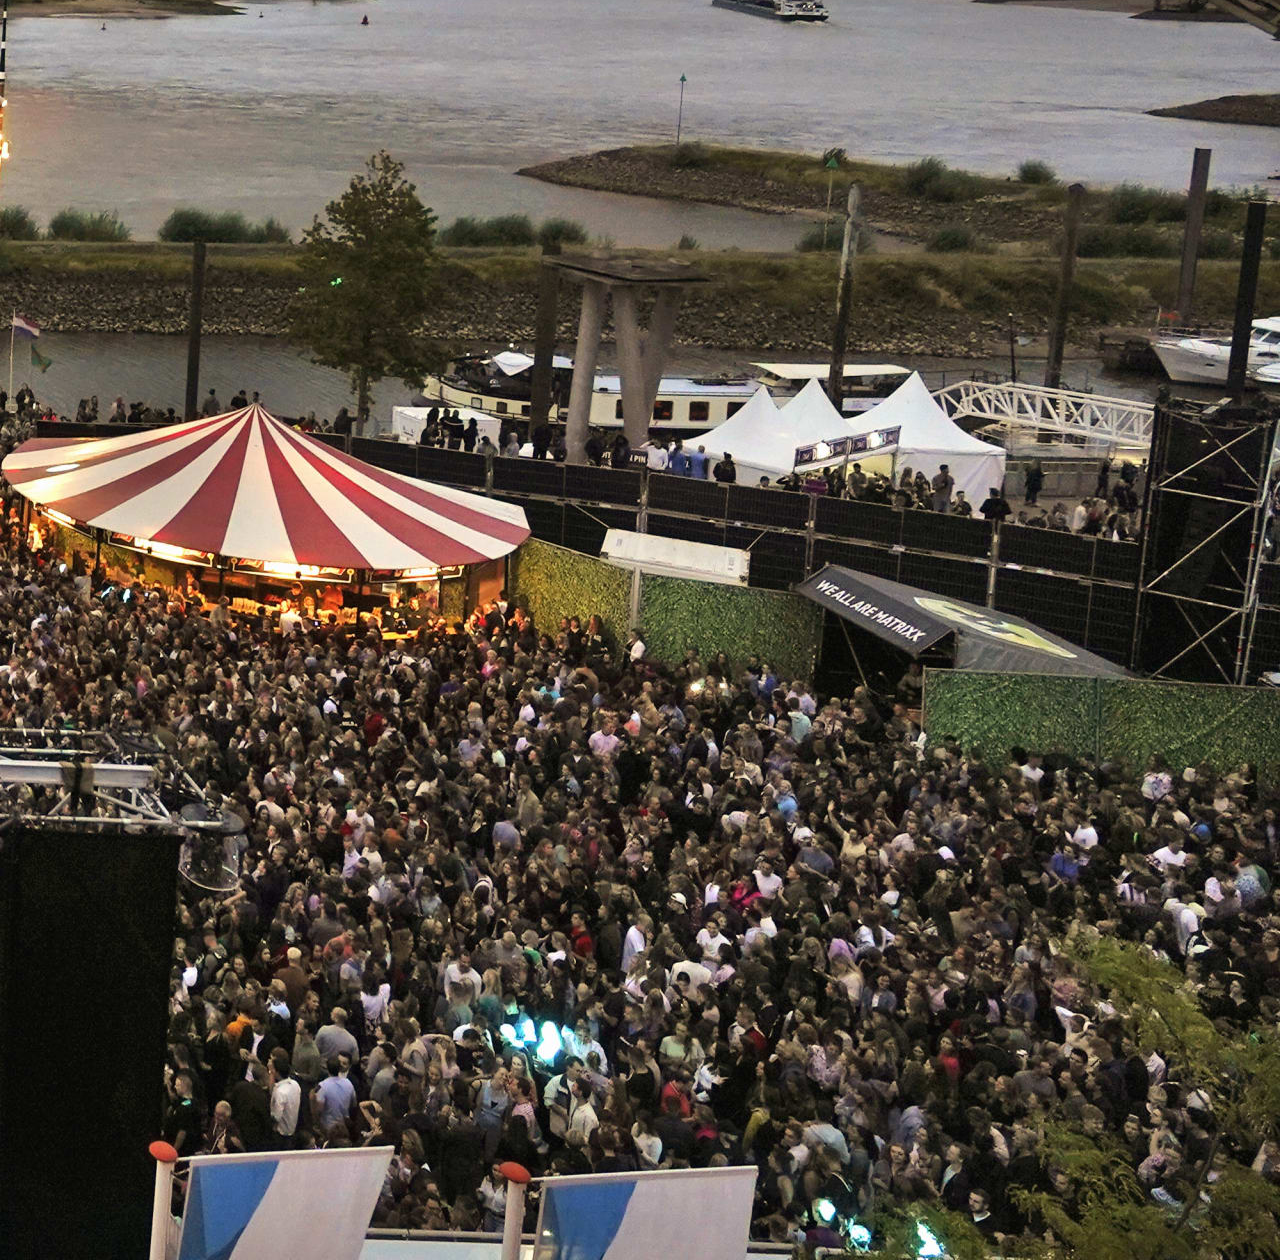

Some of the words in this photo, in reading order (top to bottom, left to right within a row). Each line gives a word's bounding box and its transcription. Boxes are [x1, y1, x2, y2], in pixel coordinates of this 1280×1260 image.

[816, 580, 839, 596] WE
[831, 590, 855, 606] ALL
[850, 600, 879, 617] ARE
[871, 610, 927, 642] MATRIXX
